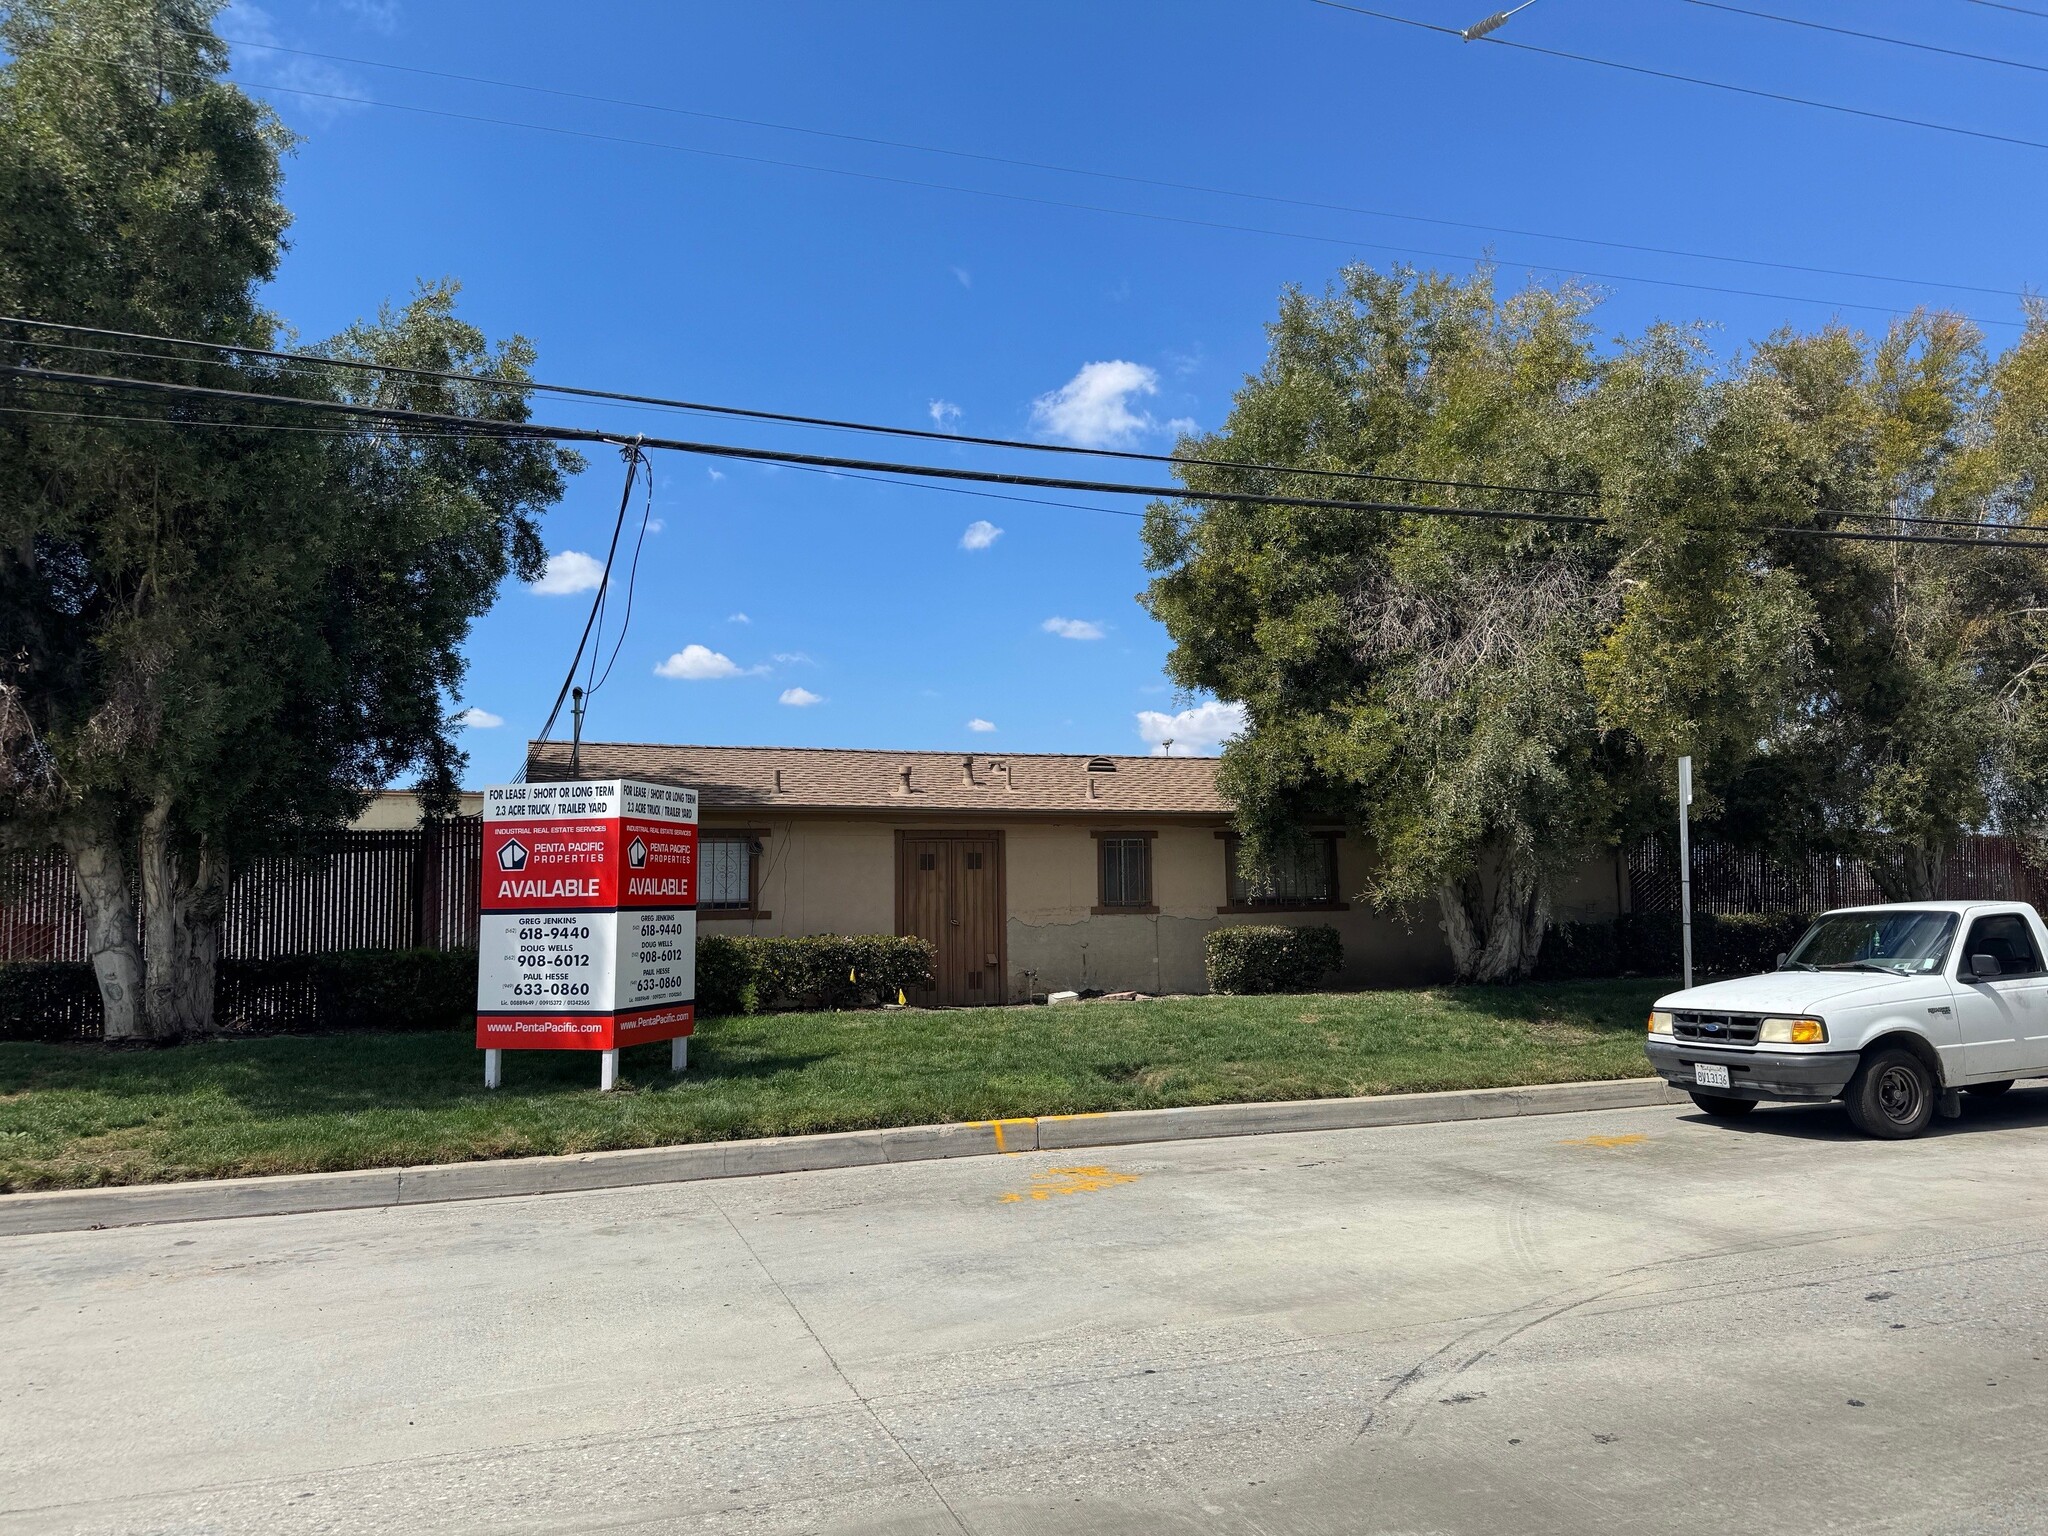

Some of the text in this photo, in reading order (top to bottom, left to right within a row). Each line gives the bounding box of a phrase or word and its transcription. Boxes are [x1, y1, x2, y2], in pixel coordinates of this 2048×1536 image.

[490, 786, 614, 800] FOR LEASE / SHORT OR LONG TERM
[624, 785, 632, 796] FOR
[634, 787, 646, 798] LEASE
[651, 789, 664, 800] SHORT
[665, 791, 671, 801] OR
[673, 792, 684, 802] LONG
[685, 794, 696, 804] TERM
[496, 802, 607, 816] 2.3 ACRE TRUCK / TRAILER YARD
[635, 803, 646, 814] ACRE
[647, 804, 660, 815] TRUCK
[665, 806, 680, 817] TRAILER
[682, 808, 692, 818] YARD
[534, 842, 604, 852] PENTA PACIFIC
[650, 843, 690, 854] PENTA PACIFIC
[534, 854, 604, 863] PROPERTIES
[650, 854, 690, 864] PROPERTIES
[498, 879, 599, 898] AVAILABLE
[628, 878, 687, 895] AVAILABLE
[519, 927, 589, 940] 618-9440
[641, 924, 682, 936] 618-9440
[518, 955, 589, 967] 908-6012
[640, 949, 681, 963] 908-6012
[514, 983, 589, 995] 633-0860
[637, 976, 681, 991] 633-0860
[487, 1022, 602, 1032] www.PentaPacific.com
[620, 1013, 688, 1030] www.PentaPacific.com
